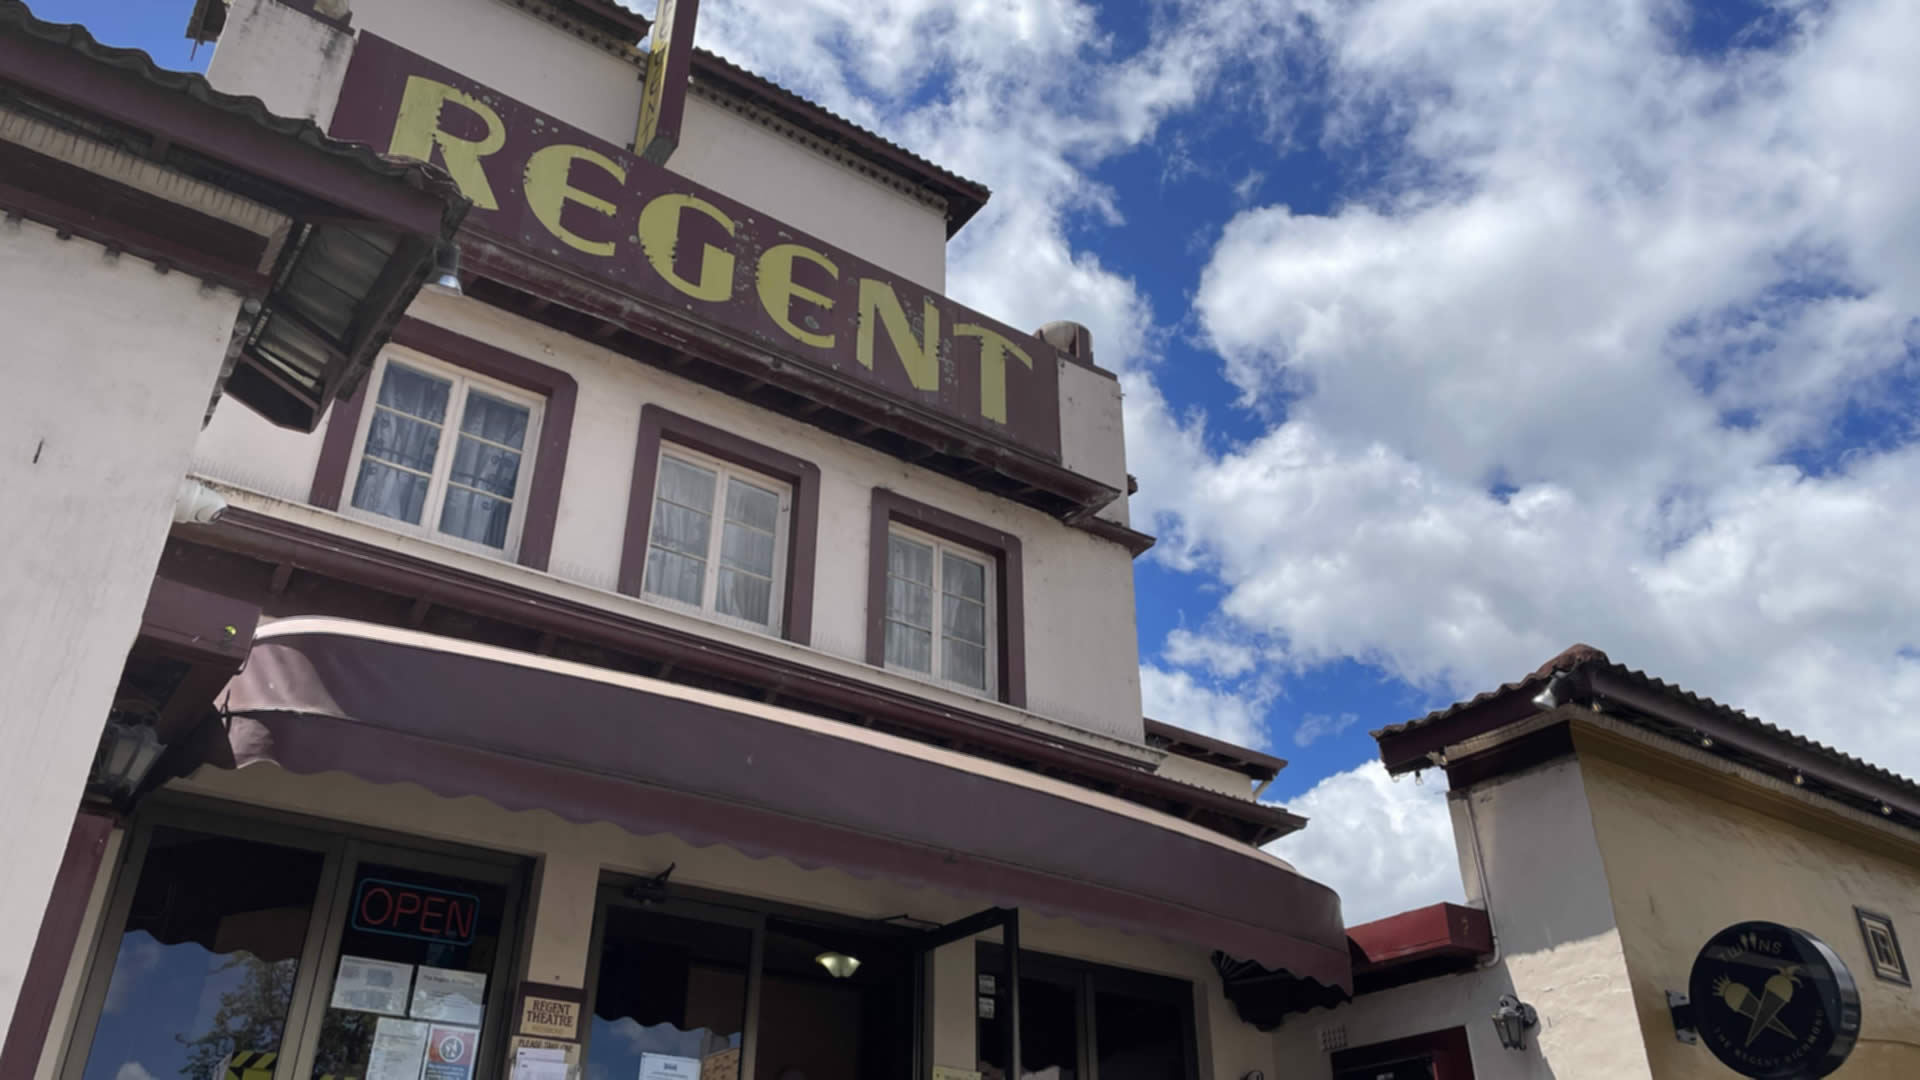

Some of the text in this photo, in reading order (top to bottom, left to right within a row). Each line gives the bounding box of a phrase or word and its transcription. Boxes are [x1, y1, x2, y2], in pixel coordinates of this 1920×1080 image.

[388, 75, 1033, 425] REGENT
[361, 887, 474, 936] OPEN
[527, 1010, 574, 1028] THEATRE
[532, 1000, 571, 1015] REGENT
